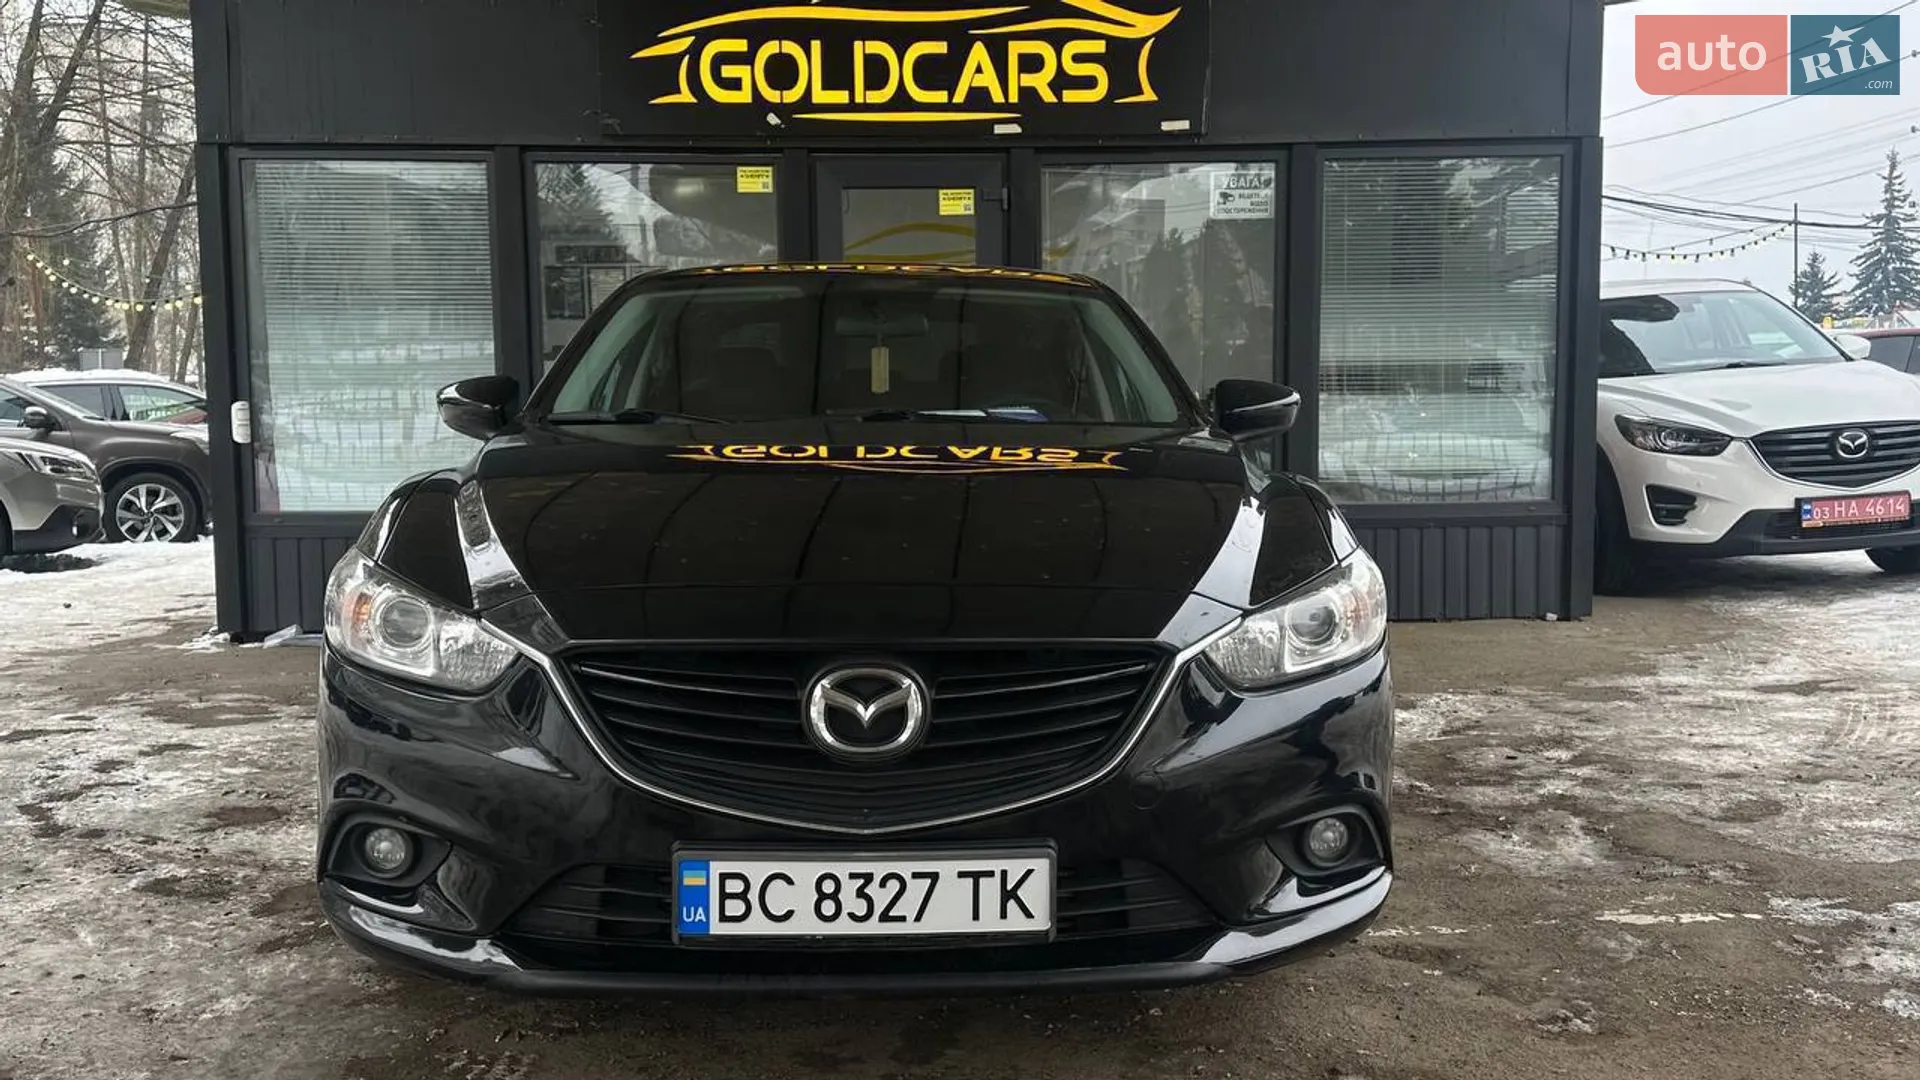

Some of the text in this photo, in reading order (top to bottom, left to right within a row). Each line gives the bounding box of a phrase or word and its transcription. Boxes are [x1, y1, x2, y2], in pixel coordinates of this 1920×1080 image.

[700, 38, 1109, 104] GOLDCARS
[1813, 507, 1830, 519] 03
[1834, 500, 1860, 518] HA
[1865, 497, 1905, 515] 4614
[683, 868, 1036, 923] UA BC 8327 TK
